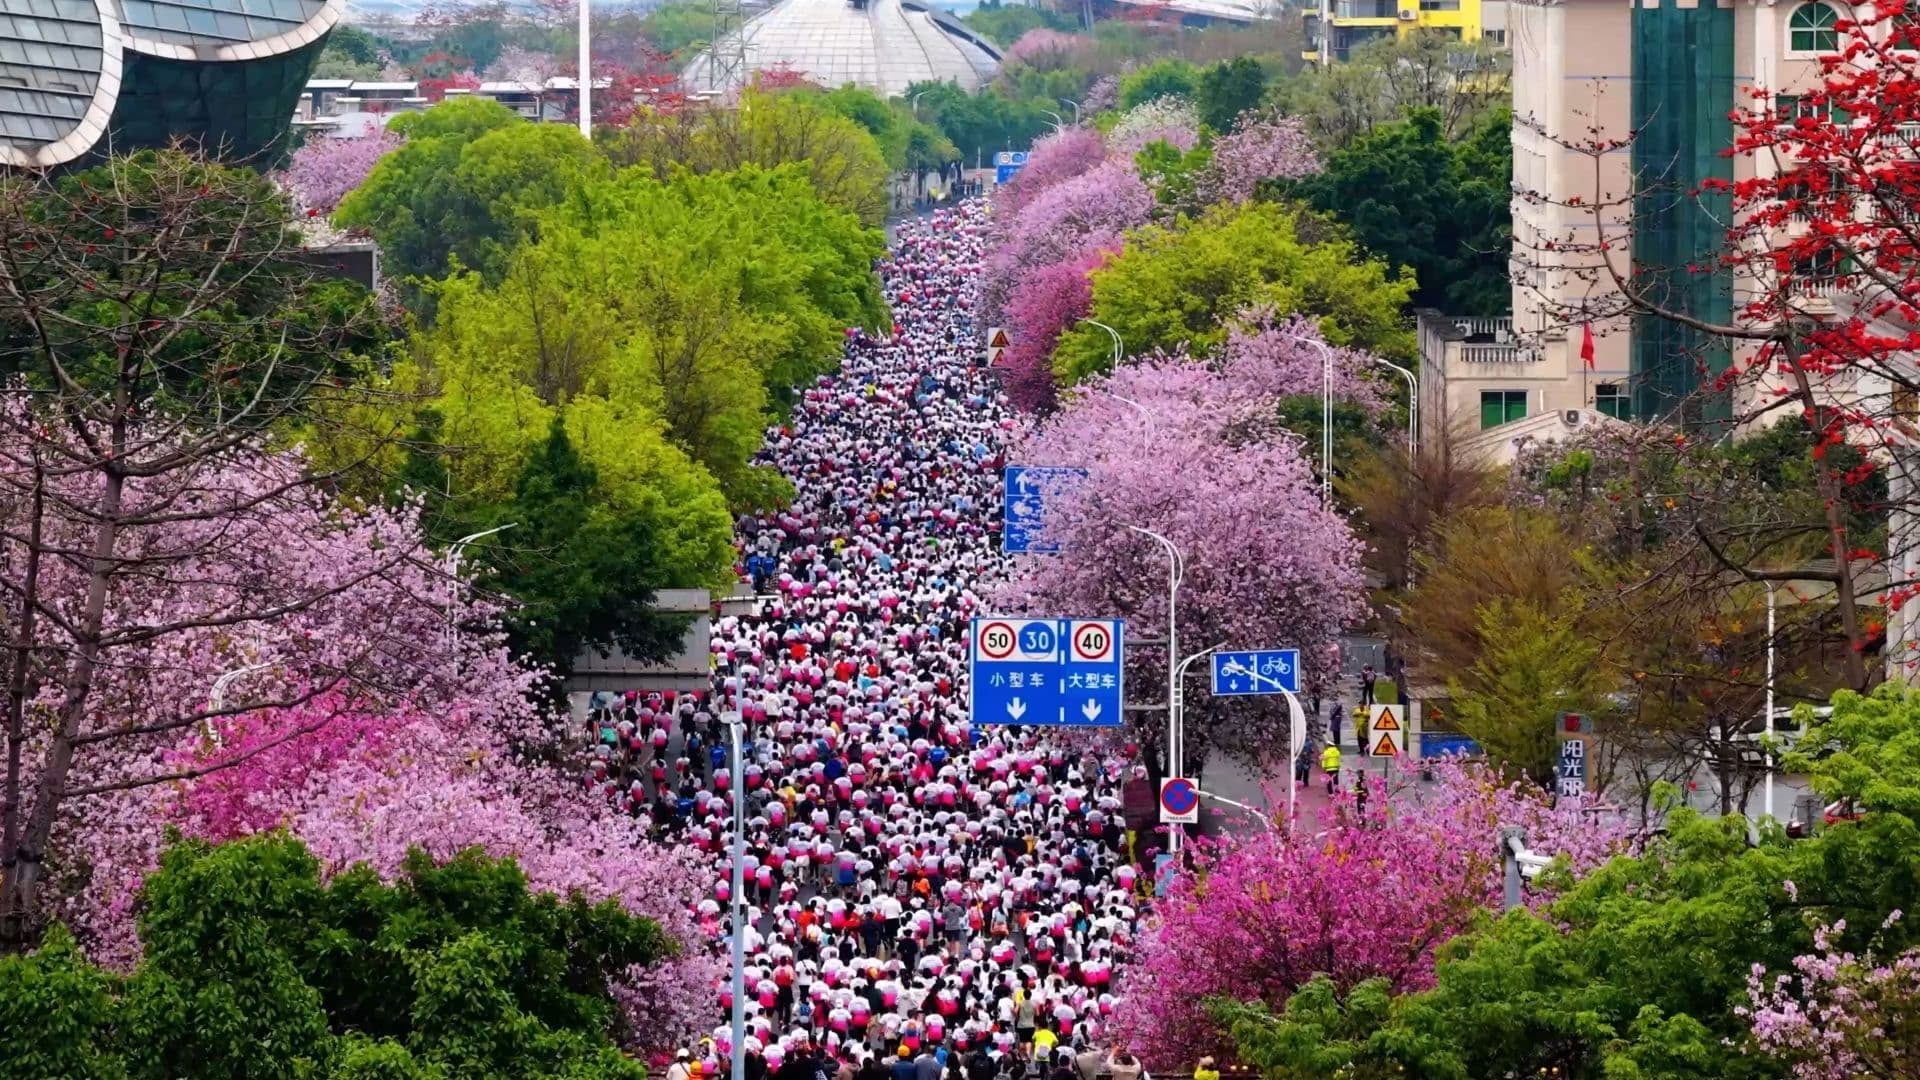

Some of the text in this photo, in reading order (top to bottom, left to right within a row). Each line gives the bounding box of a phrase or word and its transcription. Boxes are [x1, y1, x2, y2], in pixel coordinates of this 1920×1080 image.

[988, 633, 1008, 648] 50
[1026, 632, 1049, 650] 30
[1082, 633, 1103, 650] 40
[990, 672, 1045, 688] 小型车
[1069, 672, 1116, 689] 大型车
